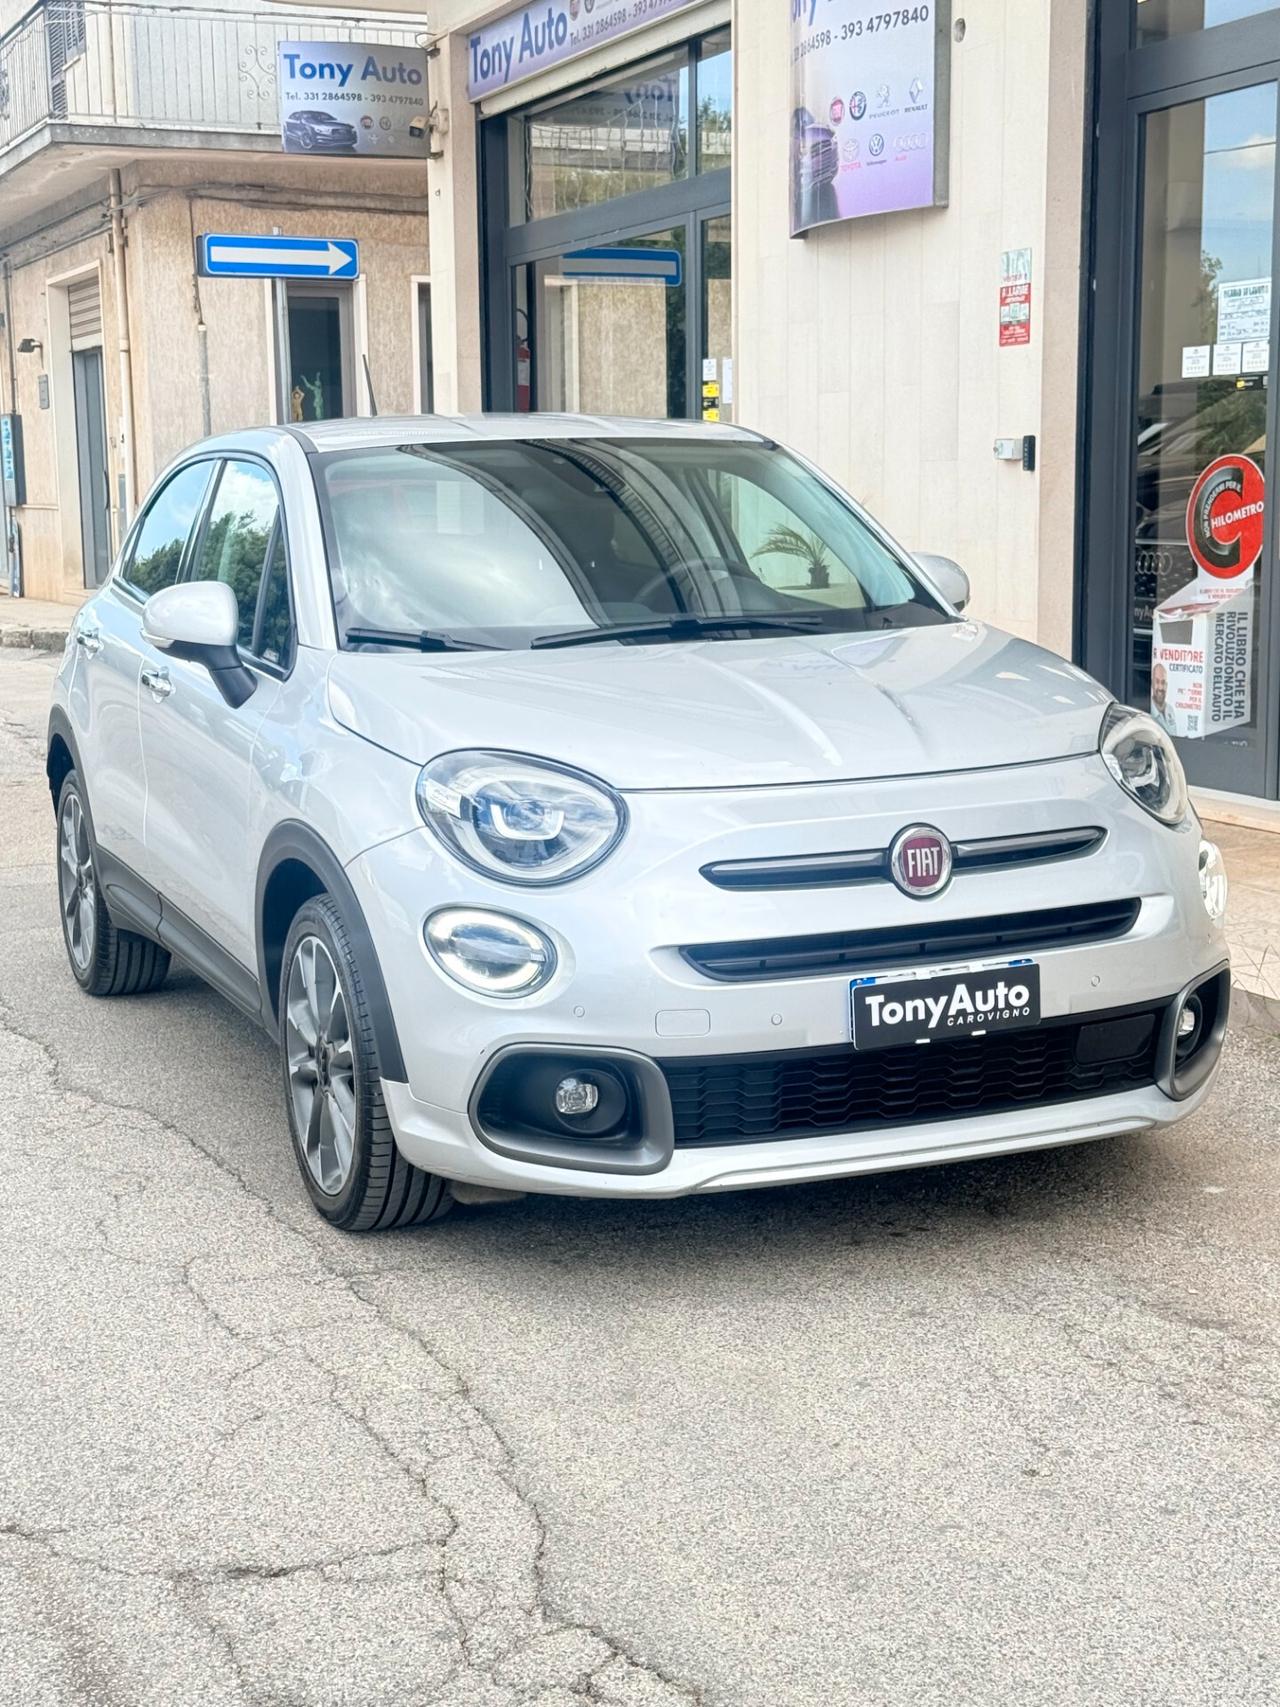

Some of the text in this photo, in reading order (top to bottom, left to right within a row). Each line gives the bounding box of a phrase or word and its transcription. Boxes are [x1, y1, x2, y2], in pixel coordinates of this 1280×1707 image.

[841, 20, 864, 41] 393
[866, 4, 929, 33] 4797840
[470, 7, 568, 83] Tony Auto
[283, 53, 422, 87] Tony Auto
[304, 92, 319, 101] 331
[322, 92, 362, 102] 2864598
[1211, 501, 1264, 529] HILOMETRO
[1213, 612, 1225, 664] MERCATO
[1169, 663, 1204, 674] CERTIFICATO
[1222, 611, 1236, 721] RIVOLUZIONATO IL
[1233, 611, 1248, 719] IL LIBRO CHE HA
[1211, 666, 1223, 722] DELL'AUTO
[907, 846, 940, 878] FIAT
[865, 981, 1030, 1029] TonyAuto
[947, 1006, 1031, 1027] CAROVIGNO
